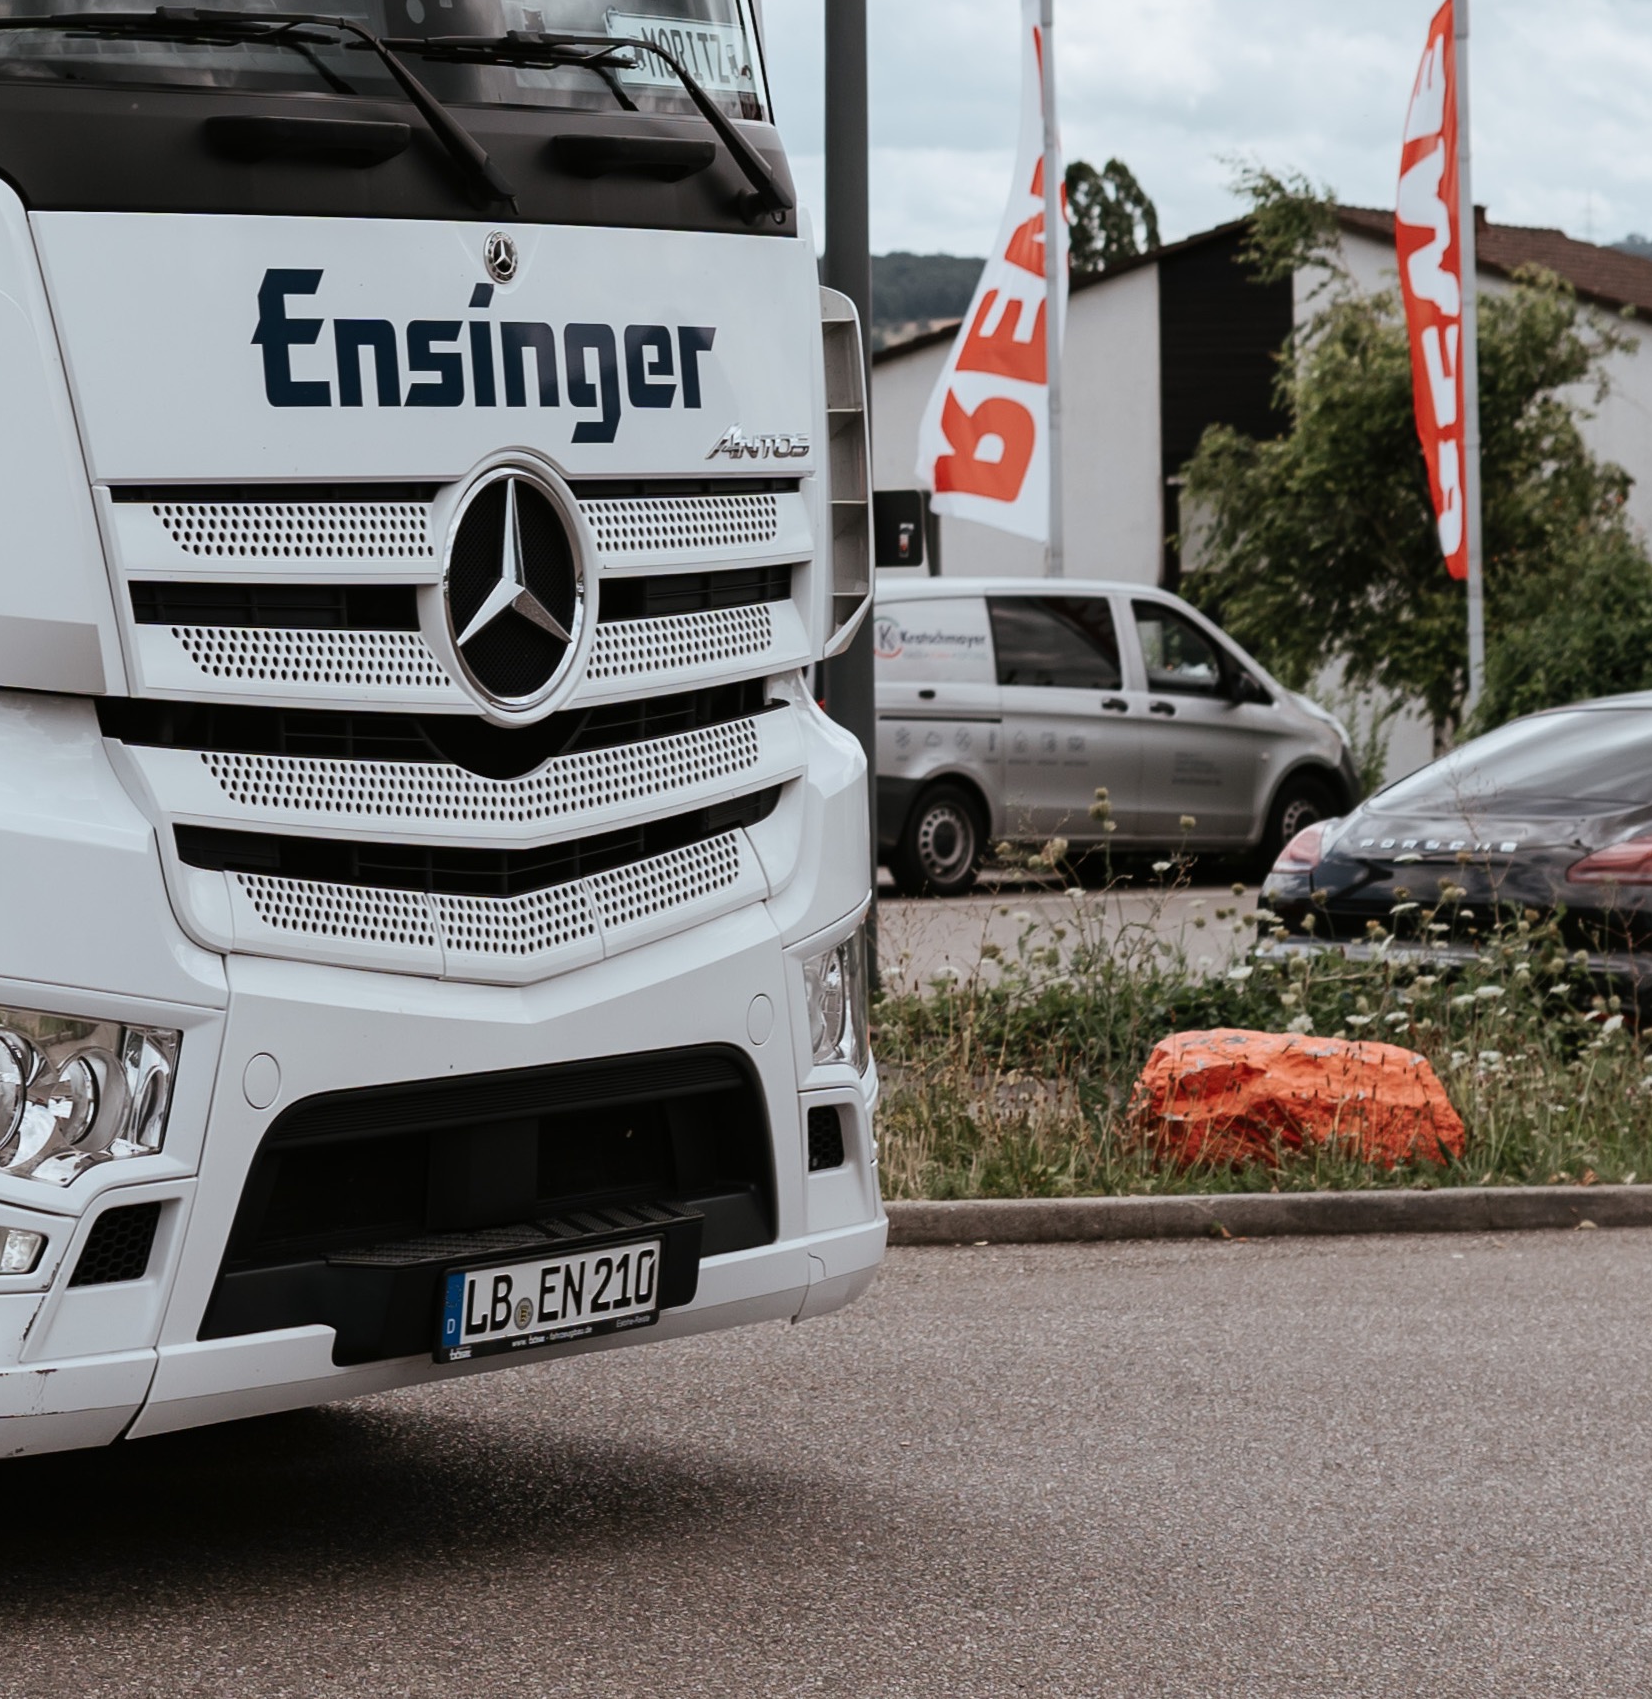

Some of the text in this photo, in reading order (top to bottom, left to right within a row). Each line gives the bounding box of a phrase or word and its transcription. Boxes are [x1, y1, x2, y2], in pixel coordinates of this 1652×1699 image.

[250, 268, 716, 443] Ensinger
[1359, 838, 1518, 853] PORSCHE
[465, 1274, 513, 1336] LB
[446, 1318, 456, 1334] D
